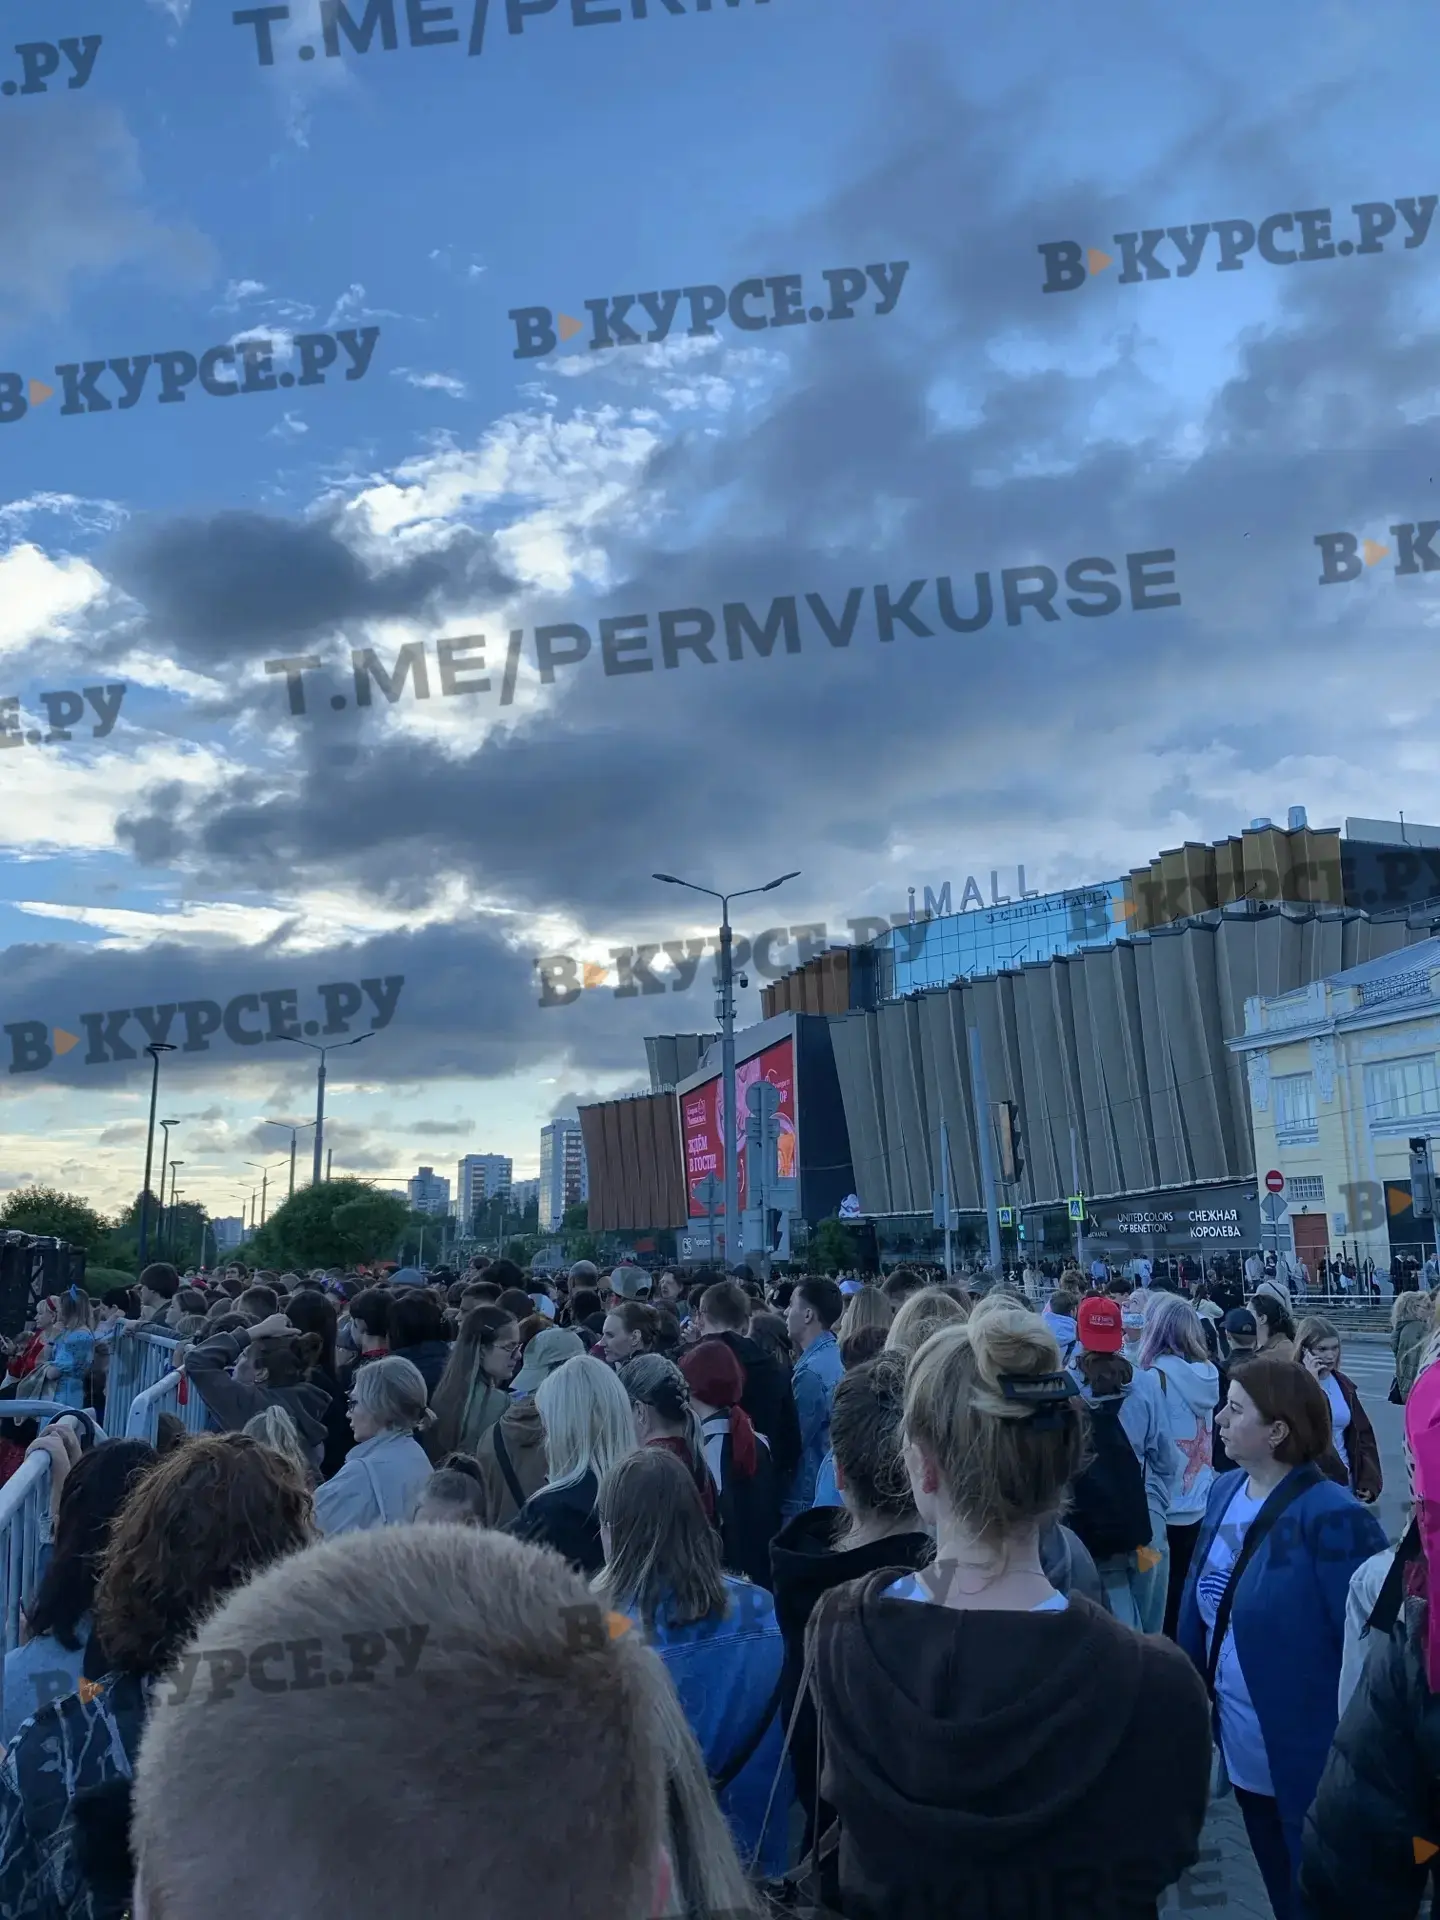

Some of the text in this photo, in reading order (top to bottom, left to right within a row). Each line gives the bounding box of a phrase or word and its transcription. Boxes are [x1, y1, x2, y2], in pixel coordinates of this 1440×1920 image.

[907, 864, 1040, 922] iMALL
[1117, 1211, 1174, 1223] UNITED COLORS
[1188, 1209, 1238, 1222] СНЕЖНАЯ
[1118, 1225, 1129, 1233] OF
[1190, 1226, 1241, 1238] КОРОЛЕВА
